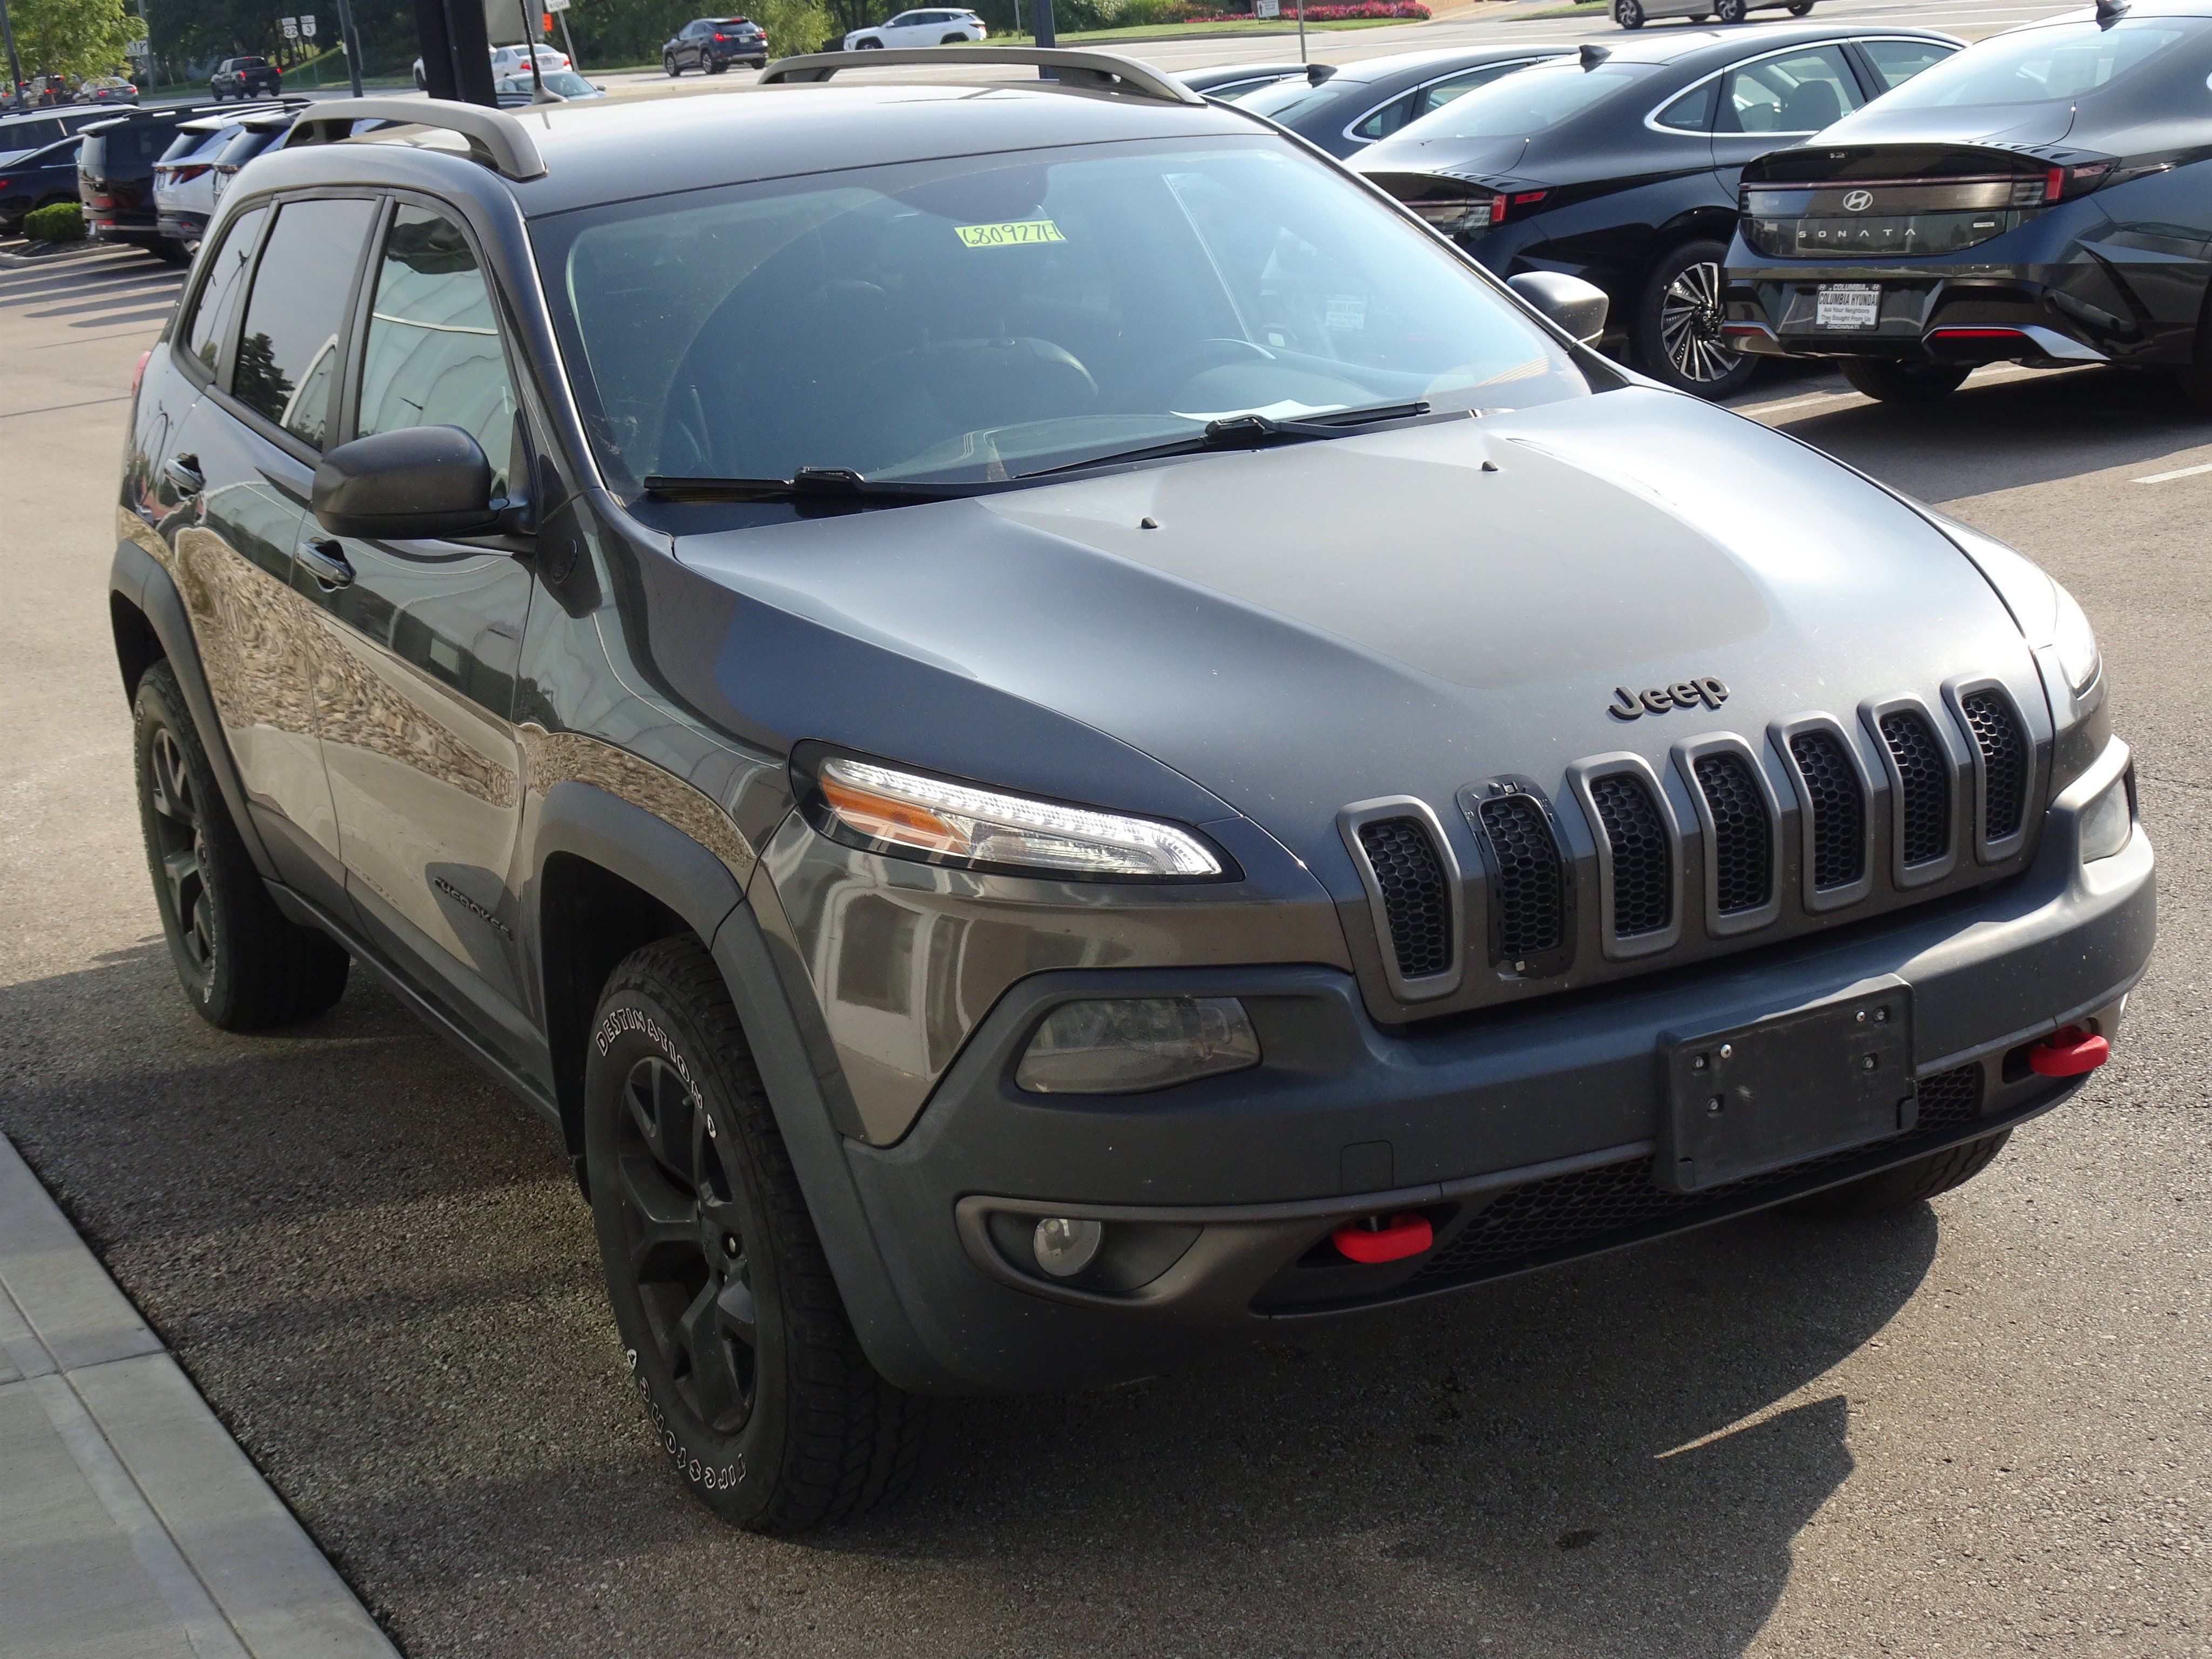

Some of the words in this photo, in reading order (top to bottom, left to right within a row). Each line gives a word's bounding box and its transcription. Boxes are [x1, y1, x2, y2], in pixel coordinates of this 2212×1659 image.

[286, 28, 296, 36] 22
[1798, 228, 1916, 238] SONATA
[1818, 293, 1850, 305] COLUMBIA
[1609, 676, 1729, 720] Jeep
[596, 1008, 703, 1109] DESTINATION
